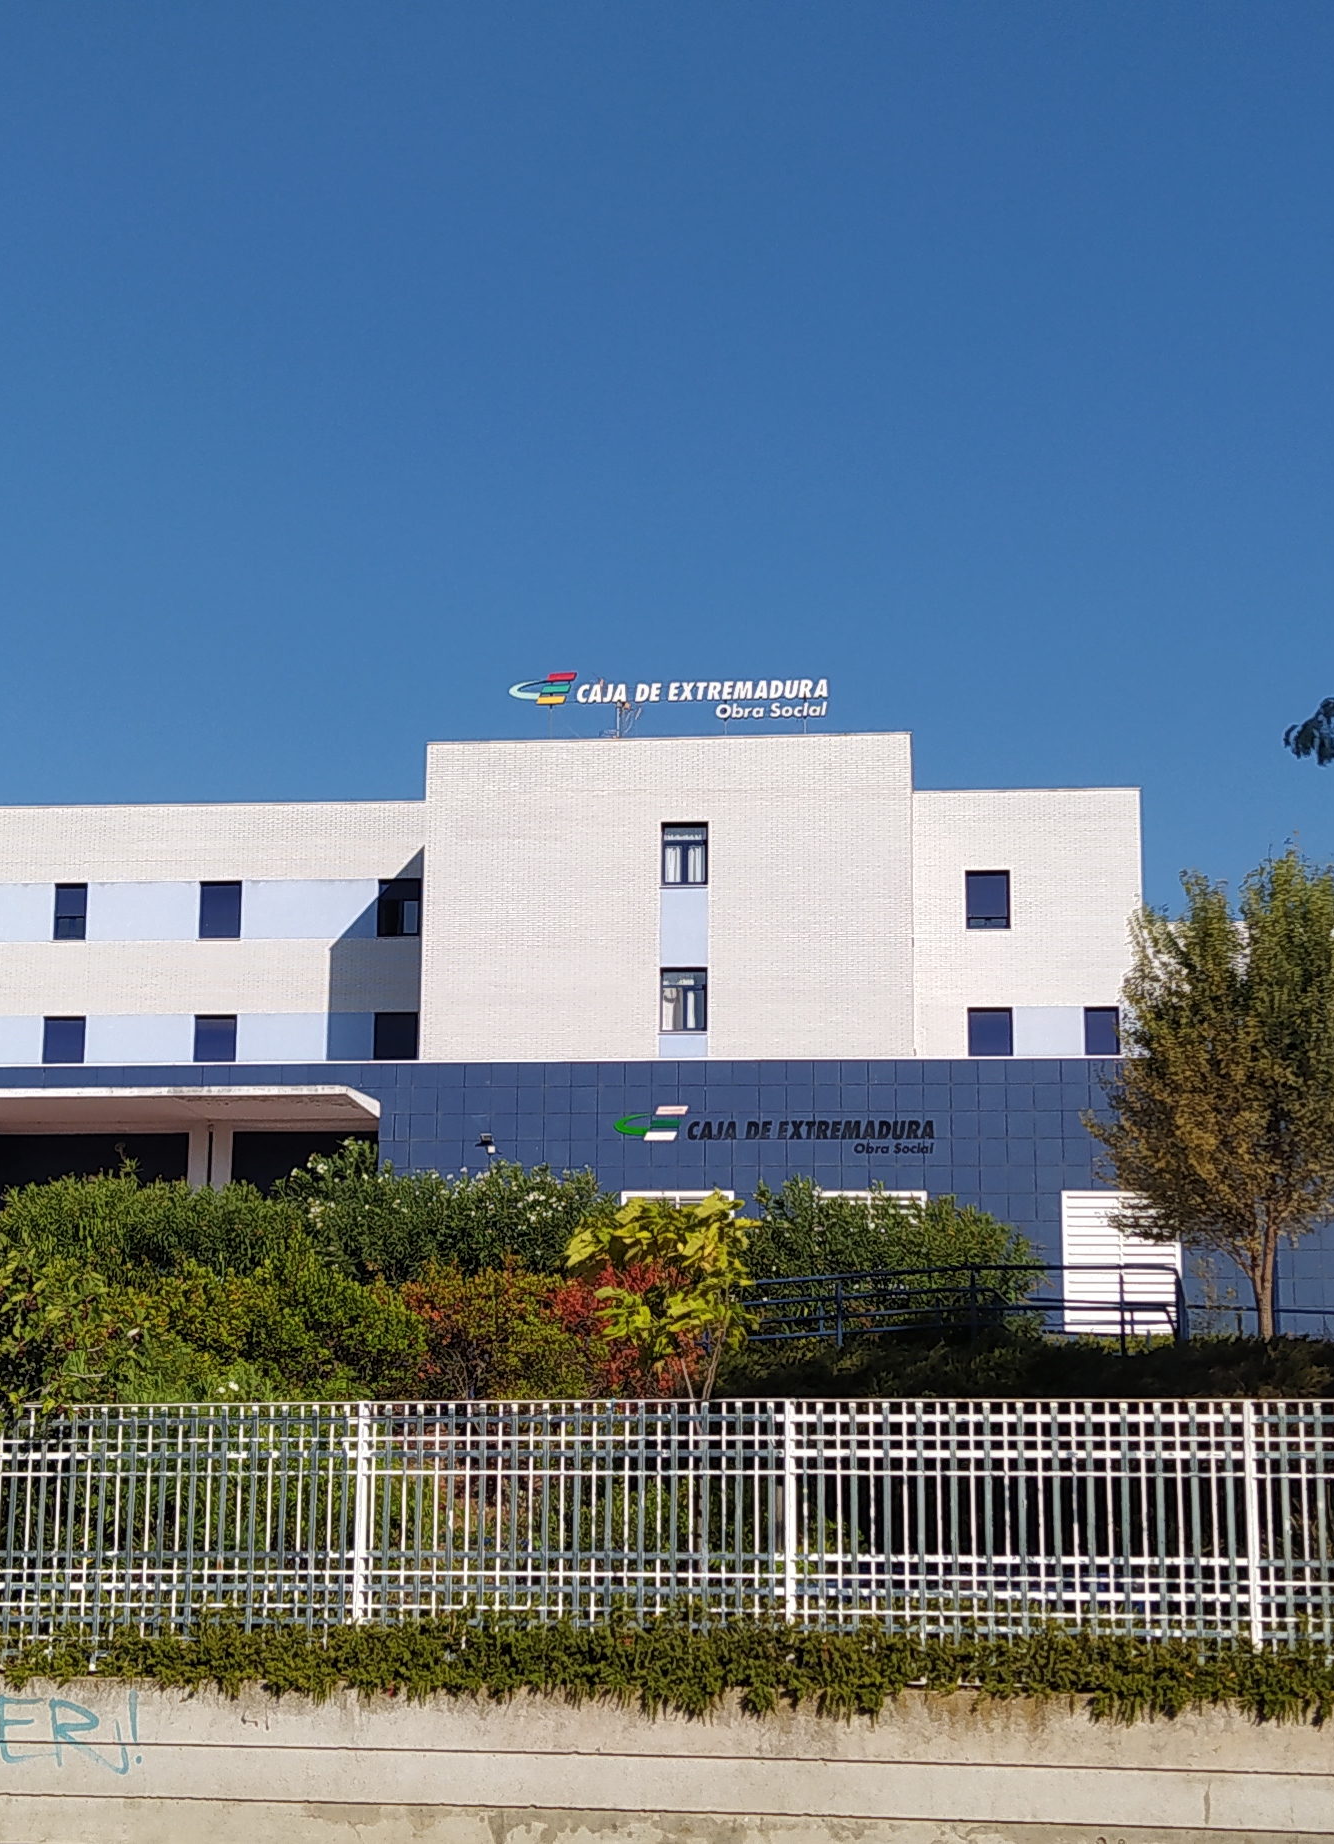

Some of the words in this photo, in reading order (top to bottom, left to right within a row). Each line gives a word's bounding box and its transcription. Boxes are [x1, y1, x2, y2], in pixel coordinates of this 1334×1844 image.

[576, 683, 627, 704] CAJA
[634, 682, 662, 703] DE
[667, 679, 829, 702] EXTREMADURA
[716, 703, 764, 719] Obra
[769, 701, 827, 718] Social
[687, 1121, 737, 1141] CAJA
[745, 1121, 774, 1140] DE
[777, 1119, 935, 1140] EXTREMADURA
[853, 1142, 890, 1155] Obra
[893, 1141, 935, 1155] Social
